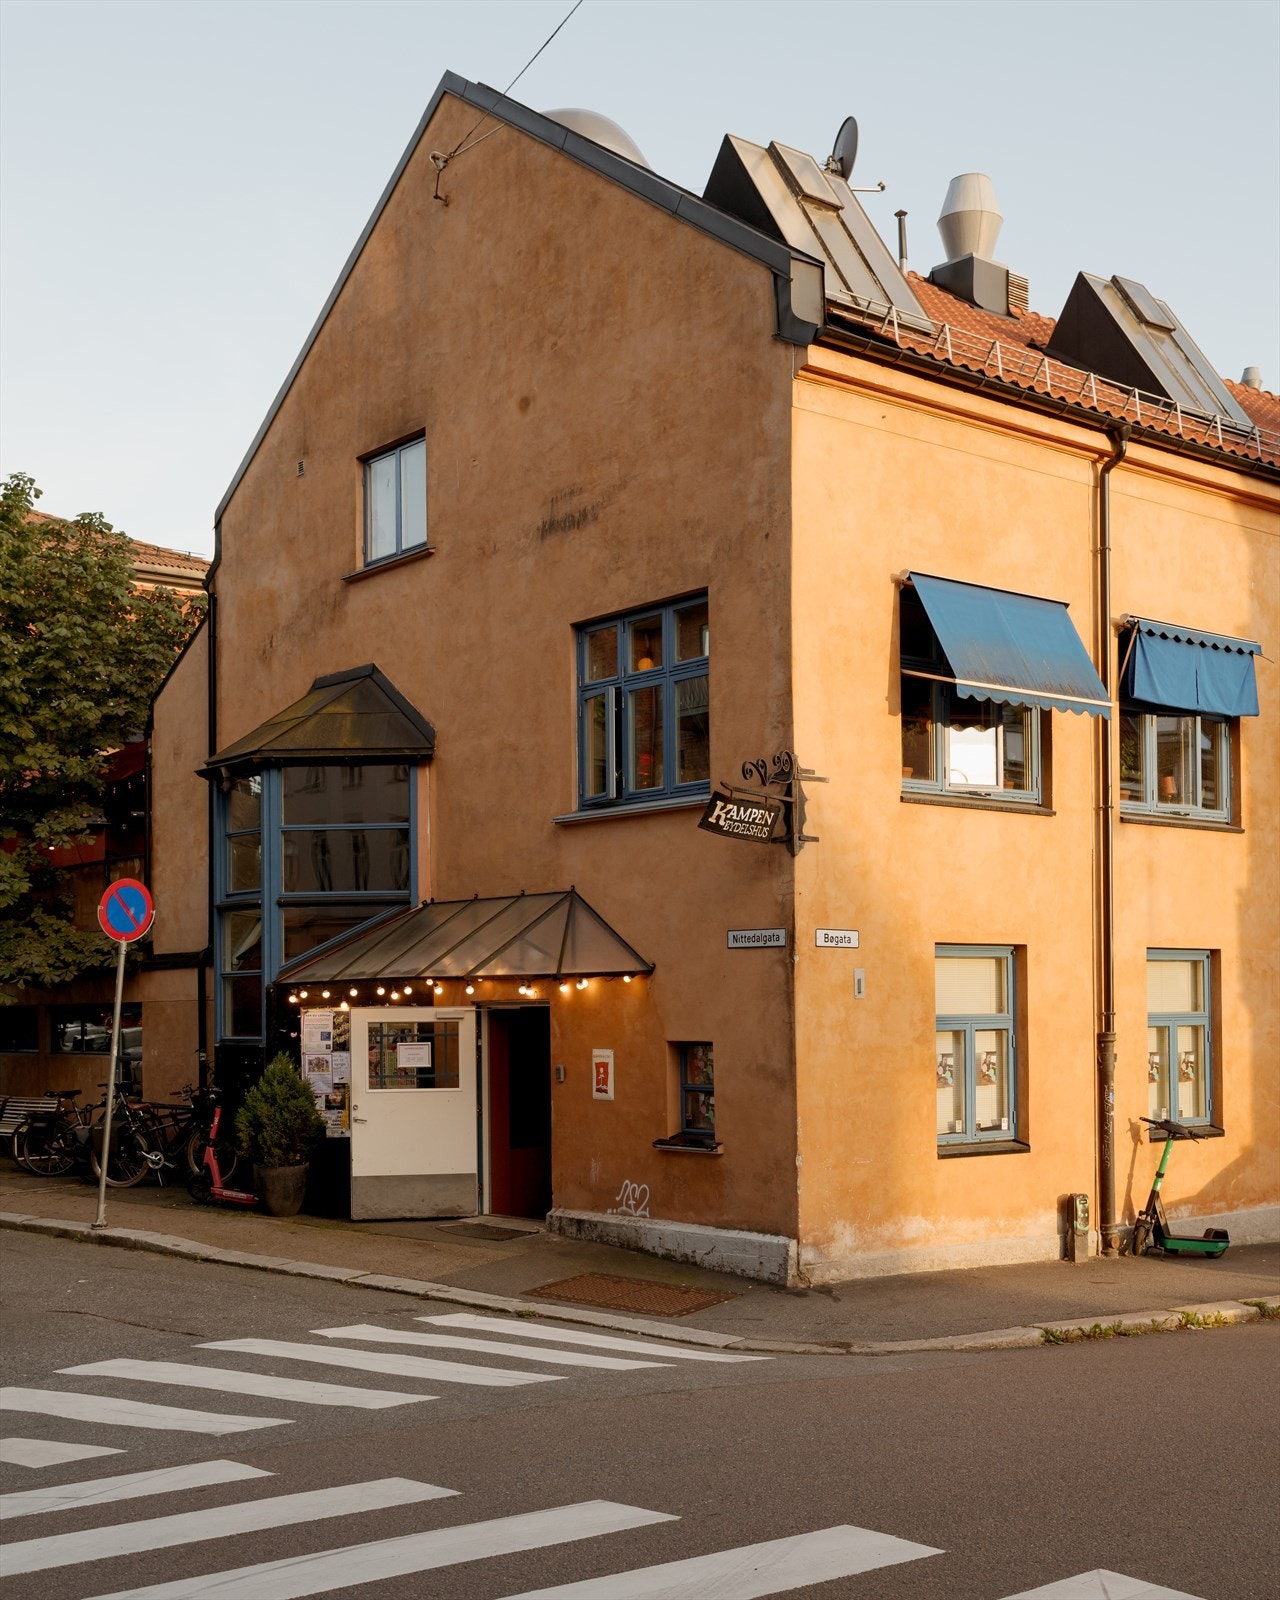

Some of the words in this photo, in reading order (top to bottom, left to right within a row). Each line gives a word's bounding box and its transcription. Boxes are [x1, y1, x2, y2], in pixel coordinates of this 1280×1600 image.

[708, 801, 775, 826] KAMPEN
[732, 932, 780, 945] Nittedalgata
[824, 933, 852, 945] Bøgata
